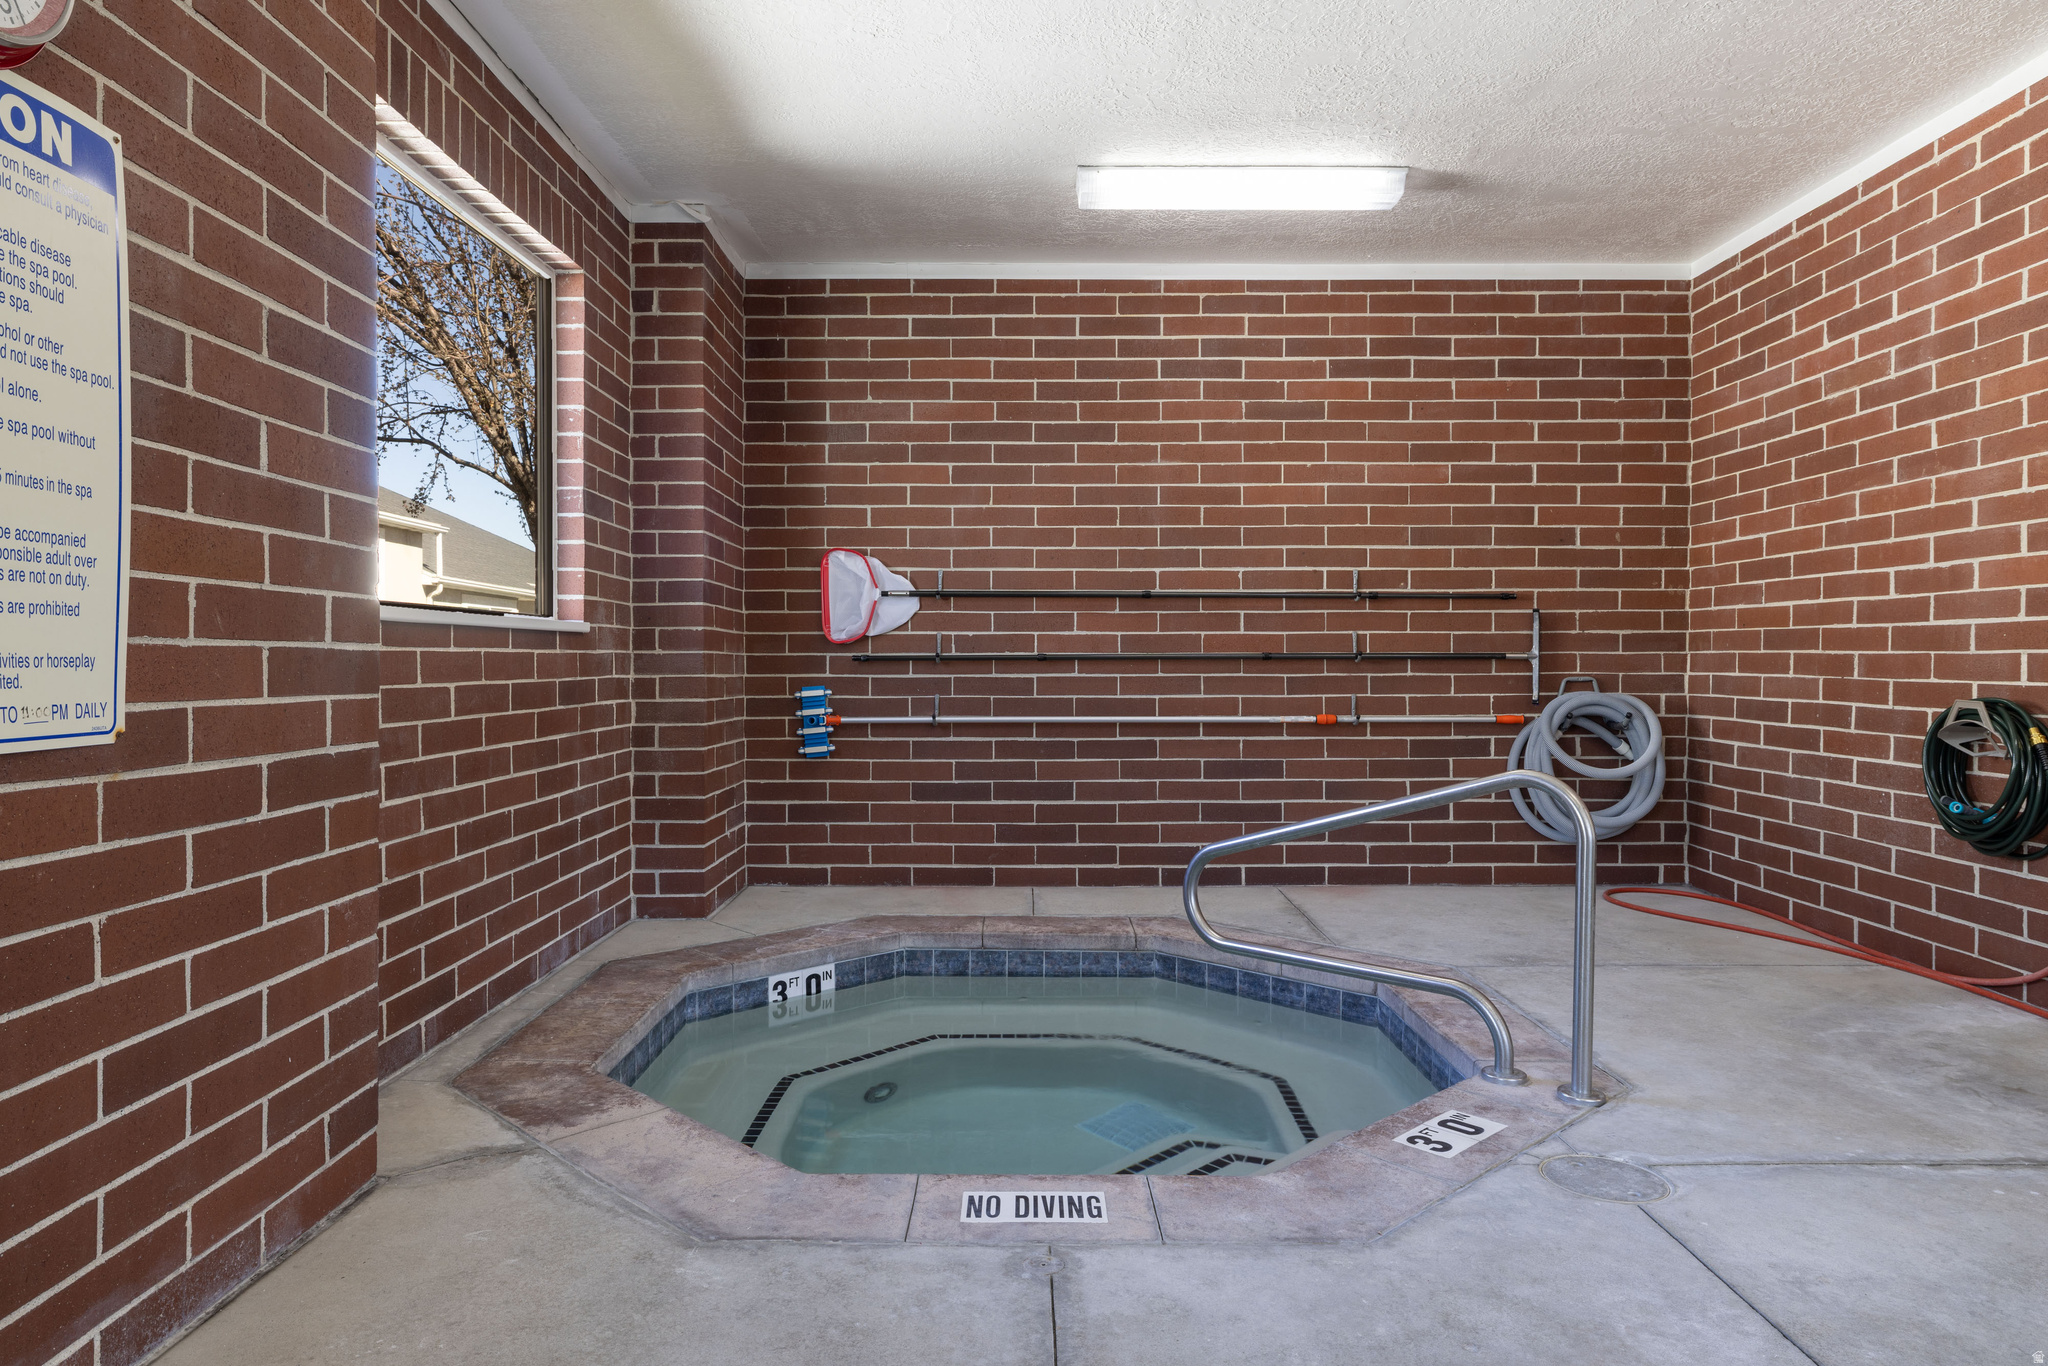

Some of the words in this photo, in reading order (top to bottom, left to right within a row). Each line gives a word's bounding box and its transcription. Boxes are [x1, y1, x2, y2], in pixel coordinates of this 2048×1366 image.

[0, 93, 72, 167] ON
[22, 161, 50, 188] heart
[15, 182, 53, 210] consult
[56, 201, 62, 214] a
[65, 204, 109, 235] physician
[30, 238, 71, 267] disease
[8, 250, 26, 269] the
[29, 260, 49, 279] spa
[52, 270, 78, 290] pool.
[29, 279, 64, 304] should
[9, 294, 33, 313] spa.
[24, 333, 35, 347] or
[37, 336, 64, 355] other
[10, 349, 27, 365] not
[30, 355, 48, 371] use
[51, 359, 67, 376] the
[70, 367, 88, 384] spa
[91, 373, 115, 390] pool.
[8, 381, 42, 403] alone.
[7, 419, 28, 437] spa
[31, 424, 55, 441] pool
[58, 429, 96, 450] without
[5, 470, 44, 490] minutes
[46, 476, 55, 493] in
[57, 479, 73, 495] the
[75, 484, 93, 501] spa
[14, 528, 86, 548] accompanied
[45, 550, 71, 566] adult
[74, 555, 97, 569] over
[7, 569, 26, 583] are
[29, 570, 46, 584] not
[49, 573, 62, 585] on
[65, 571, 90, 591] duty.
[7, 601, 25, 615] are
[28, 600, 80, 619] prohibited
[33, 656, 44, 669] or
[46, 653, 96, 672] horseplay
[0, 705, 18, 724] TO
[51, 703, 69, 721] PM
[75, 701, 108, 719] DAILY
[772, 980, 788, 1003] 3
[789, 976, 800, 988] FT
[805, 973, 821, 996] 0
[822, 970, 832, 981] IN
[1437, 1119, 1485, 1136] 0
[1449, 1112, 1471, 1121] IN
[1418, 1127, 1439, 1137] FT
[1406, 1135, 1453, 1153] 3
[966, 1195, 1001, 1218] NO
[1014, 1195, 1103, 1218] DIVING
